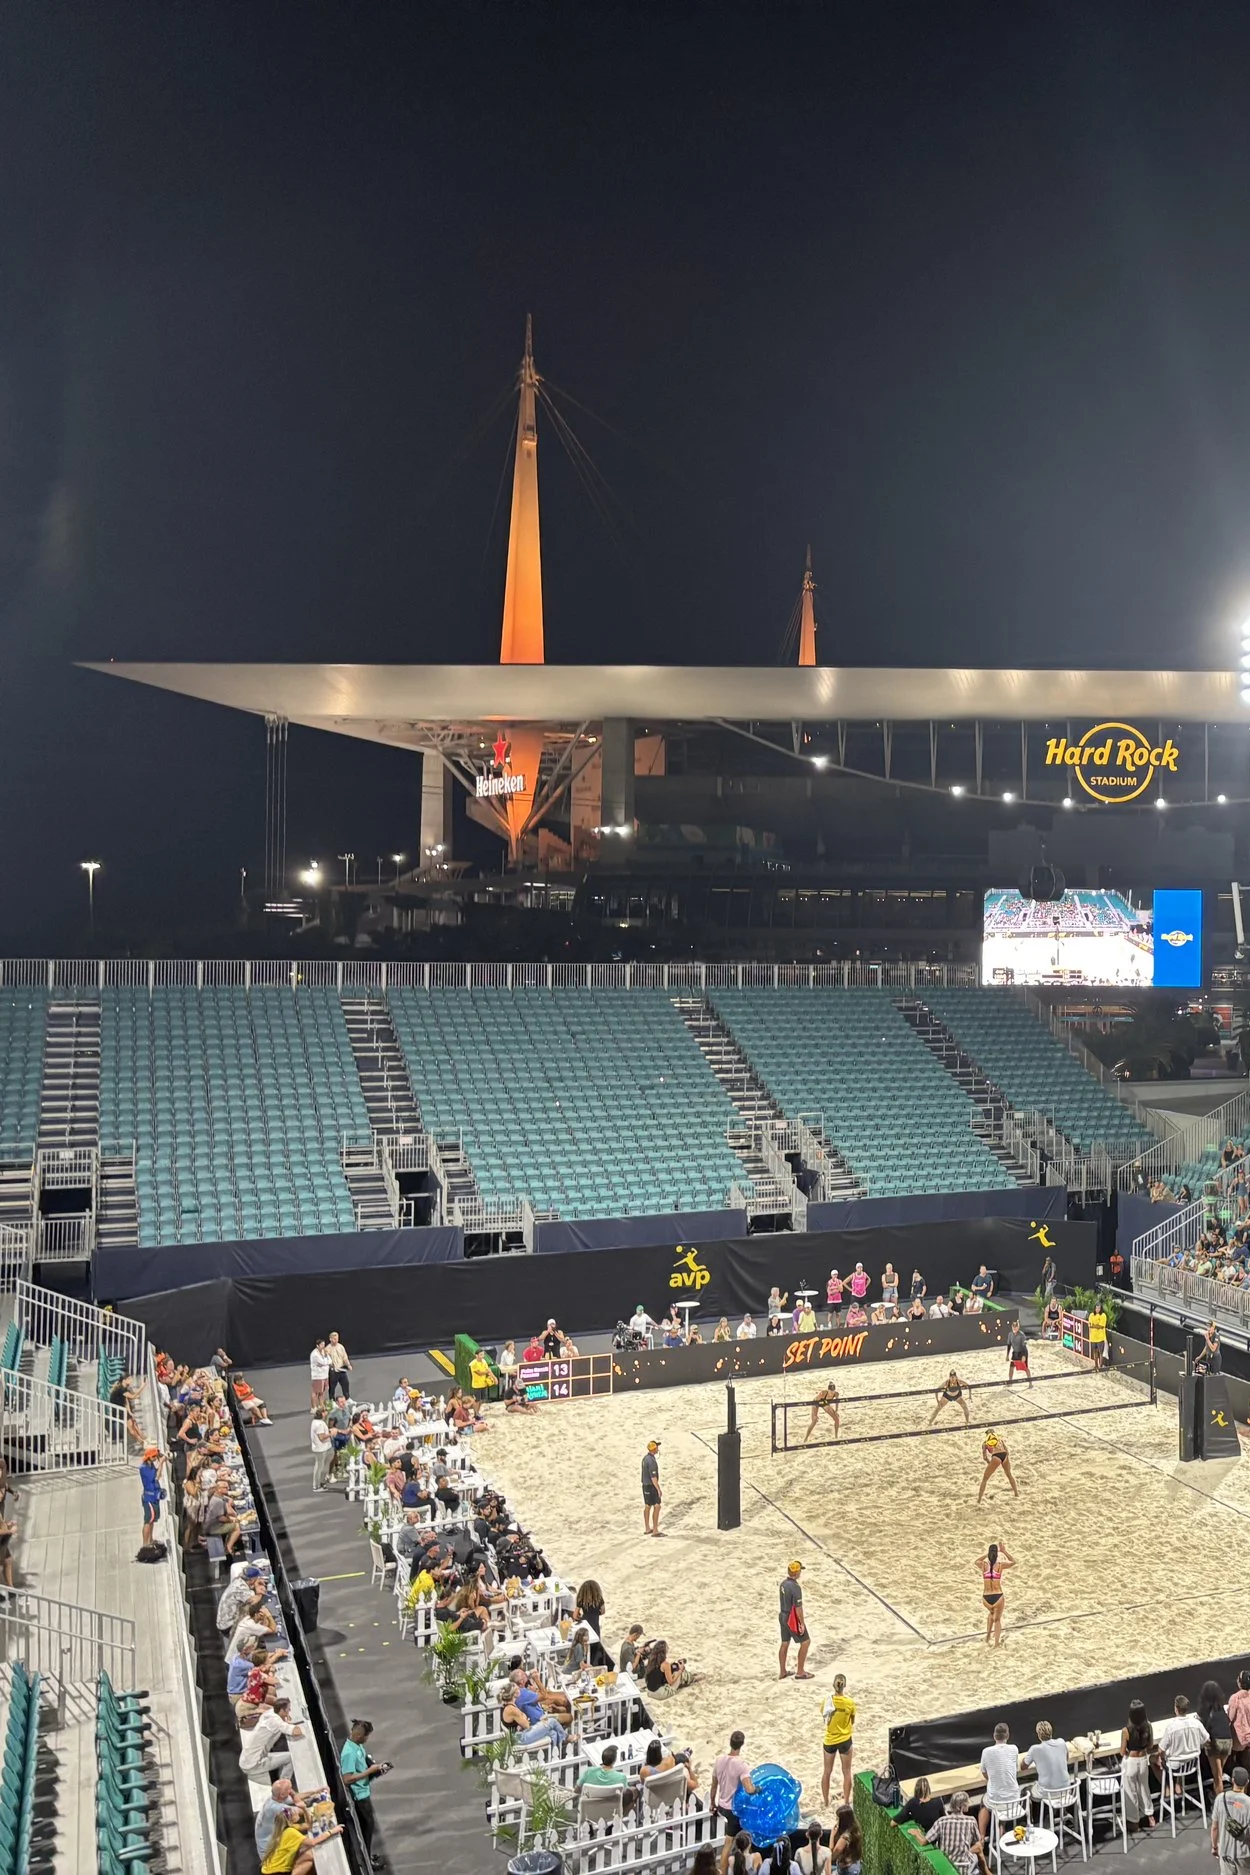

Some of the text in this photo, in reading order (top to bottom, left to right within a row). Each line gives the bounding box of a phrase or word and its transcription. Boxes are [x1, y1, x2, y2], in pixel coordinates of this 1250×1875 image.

[1045, 738, 1179, 772] Hard Rock
[476, 773, 524, 797] Heineken
[1090, 776, 1137, 786] STADIUM
[669, 1270, 711, 1290] avp
[782, 1331, 869, 1368] SET POINT
[553, 1363, 568, 1376] 13
[553, 1383, 569, 1396] 14
